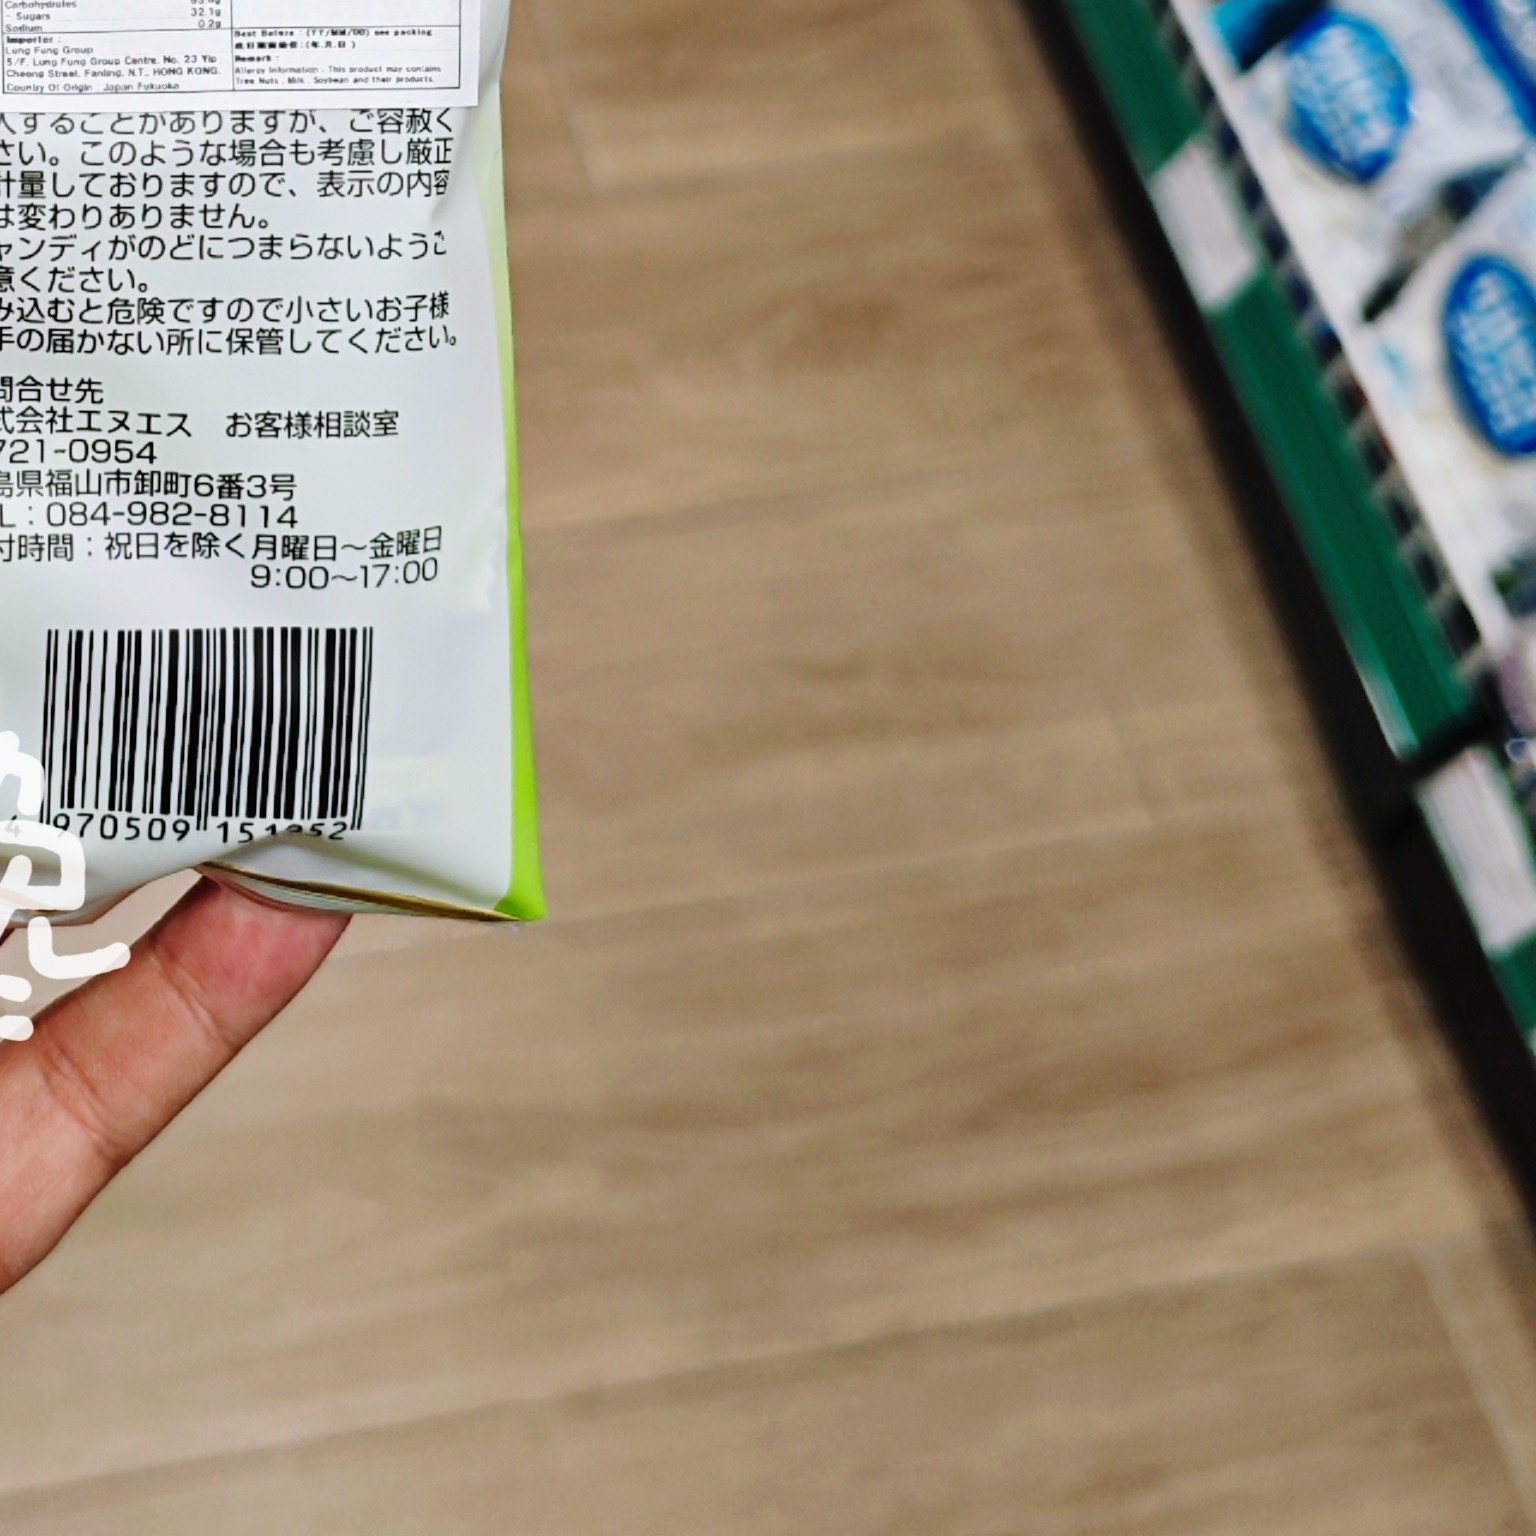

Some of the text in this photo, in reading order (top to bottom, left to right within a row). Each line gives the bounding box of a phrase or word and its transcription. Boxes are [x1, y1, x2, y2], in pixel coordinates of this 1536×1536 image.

[16, 13, 50, 21] Sugars
[5, 24, 42, 32] Sodium
[6, 46, 94, 55] Lung Fung Group
[91, 57, 120, 66] Group
[184, 55, 197, 63] 23
[153, 67, 183, 76] HONG
[103, 82, 133, 91] Japan
[226, 411, 399, 439] お客様相談室
